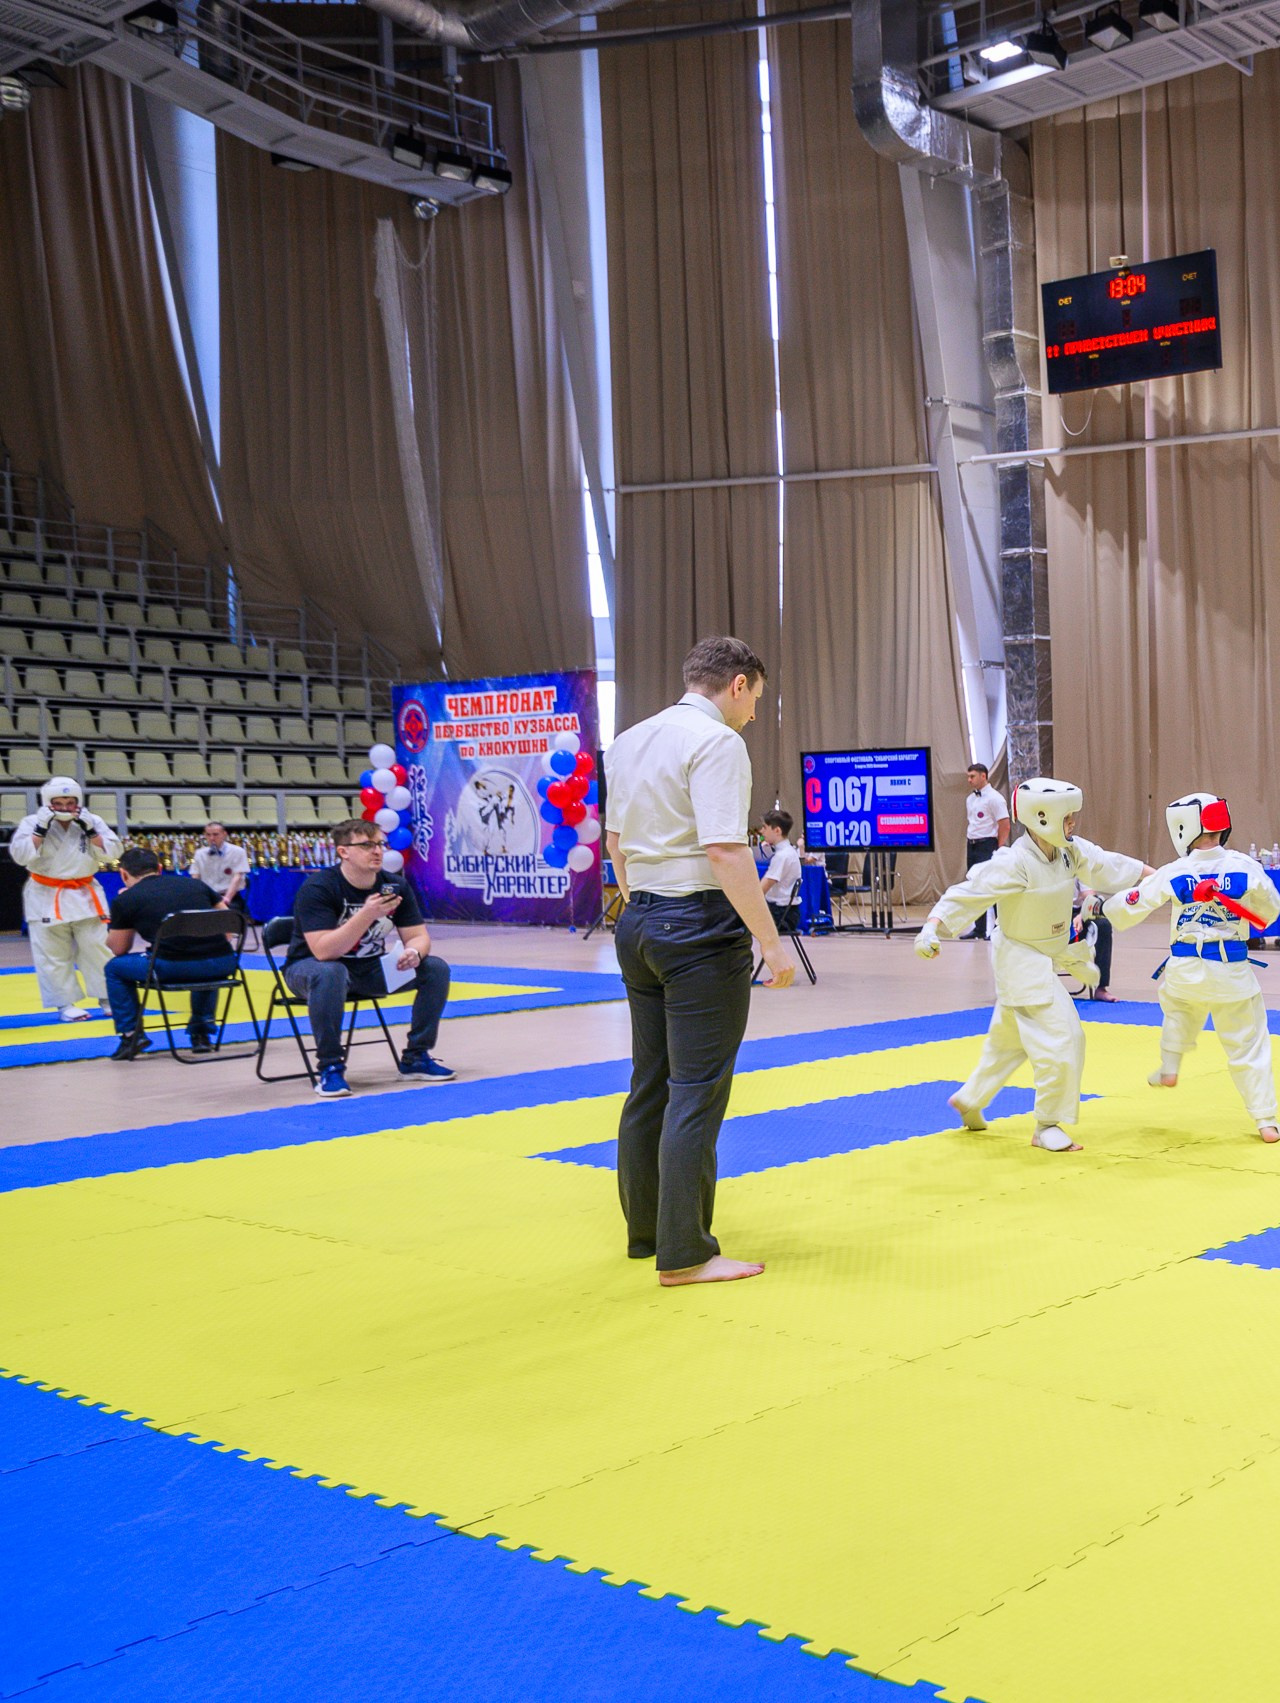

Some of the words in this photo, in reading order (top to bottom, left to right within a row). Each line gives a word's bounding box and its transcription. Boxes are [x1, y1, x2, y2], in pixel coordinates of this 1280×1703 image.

[1109, 274, 1146, 299] 13:04
[447, 690, 555, 717] ЧЕМПИОНАТ
[434, 721, 510, 739] ПЕРВЕНСТВО
[514, 716, 579, 735] КУЗБАССА
[828, 776, 873, 813] 067
[825, 820, 872, 846] 01:20
[446, 853, 537, 874] СИБИРСКИЙ
[486, 873, 569, 900] ХАРАКТЕР
